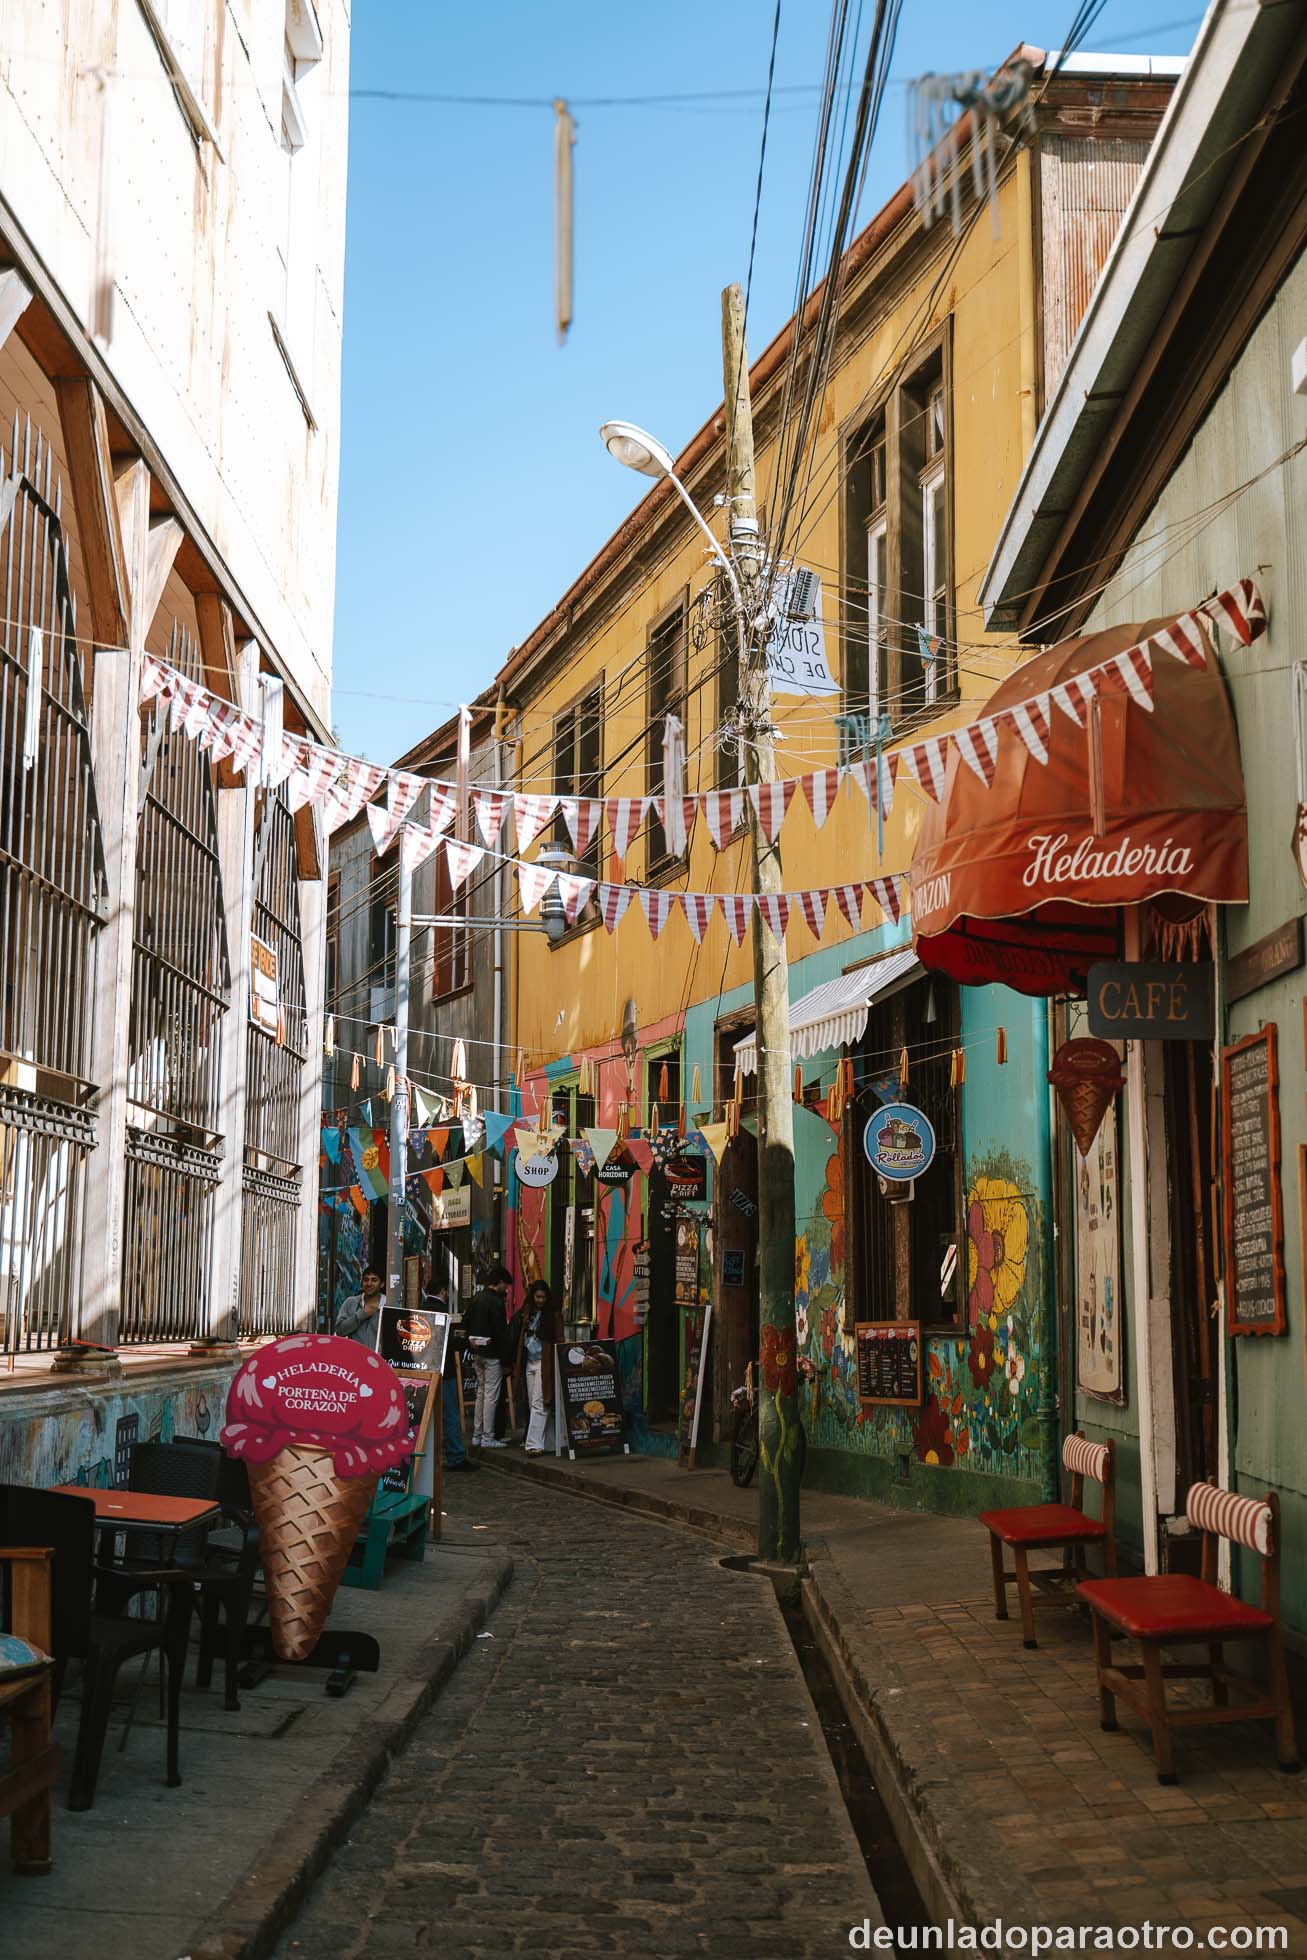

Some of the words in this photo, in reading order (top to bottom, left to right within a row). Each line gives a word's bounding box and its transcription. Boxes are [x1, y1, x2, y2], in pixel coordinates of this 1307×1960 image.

[1022, 833, 1194, 887] Heladería
[1098, 973, 1189, 1022] CAFÉ
[875, 1151, 925, 1165] Rollados
[672, 1183, 698, 1191] PIZZA
[401, 1339, 426, 1348] PIZZA
[402, 1345, 424, 1353] DRIFT
[277, 1362, 359, 1388] HELADERÍA
[278, 1386, 337, 1402] PORTEÑA
[339, 1391, 357, 1403] DE
